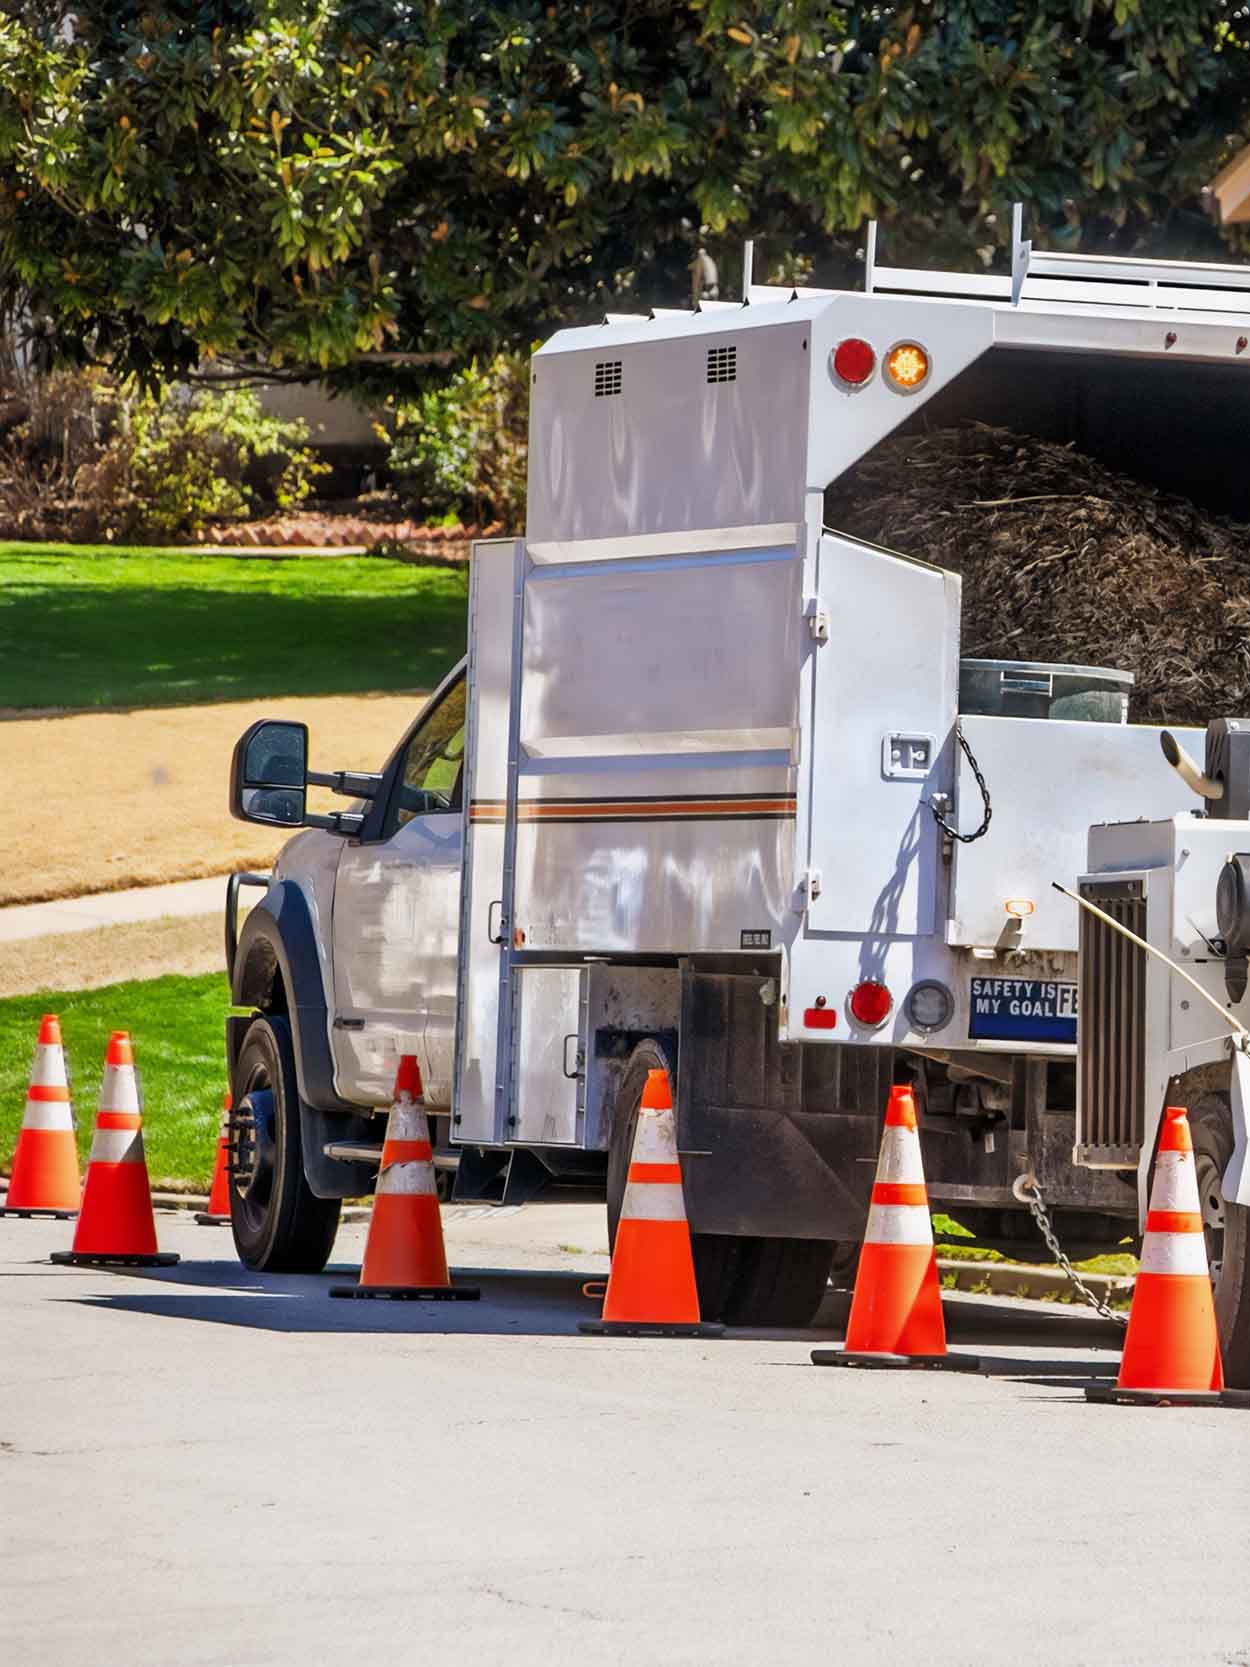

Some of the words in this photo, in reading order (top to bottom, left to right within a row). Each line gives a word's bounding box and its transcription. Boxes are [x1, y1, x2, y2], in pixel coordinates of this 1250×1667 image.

[972, 980, 1033, 998] SAFETY
[1041, 983, 1056, 999] IS
[976, 998, 1001, 1014] MY
[1009, 1000, 1053, 1017] GOAL
